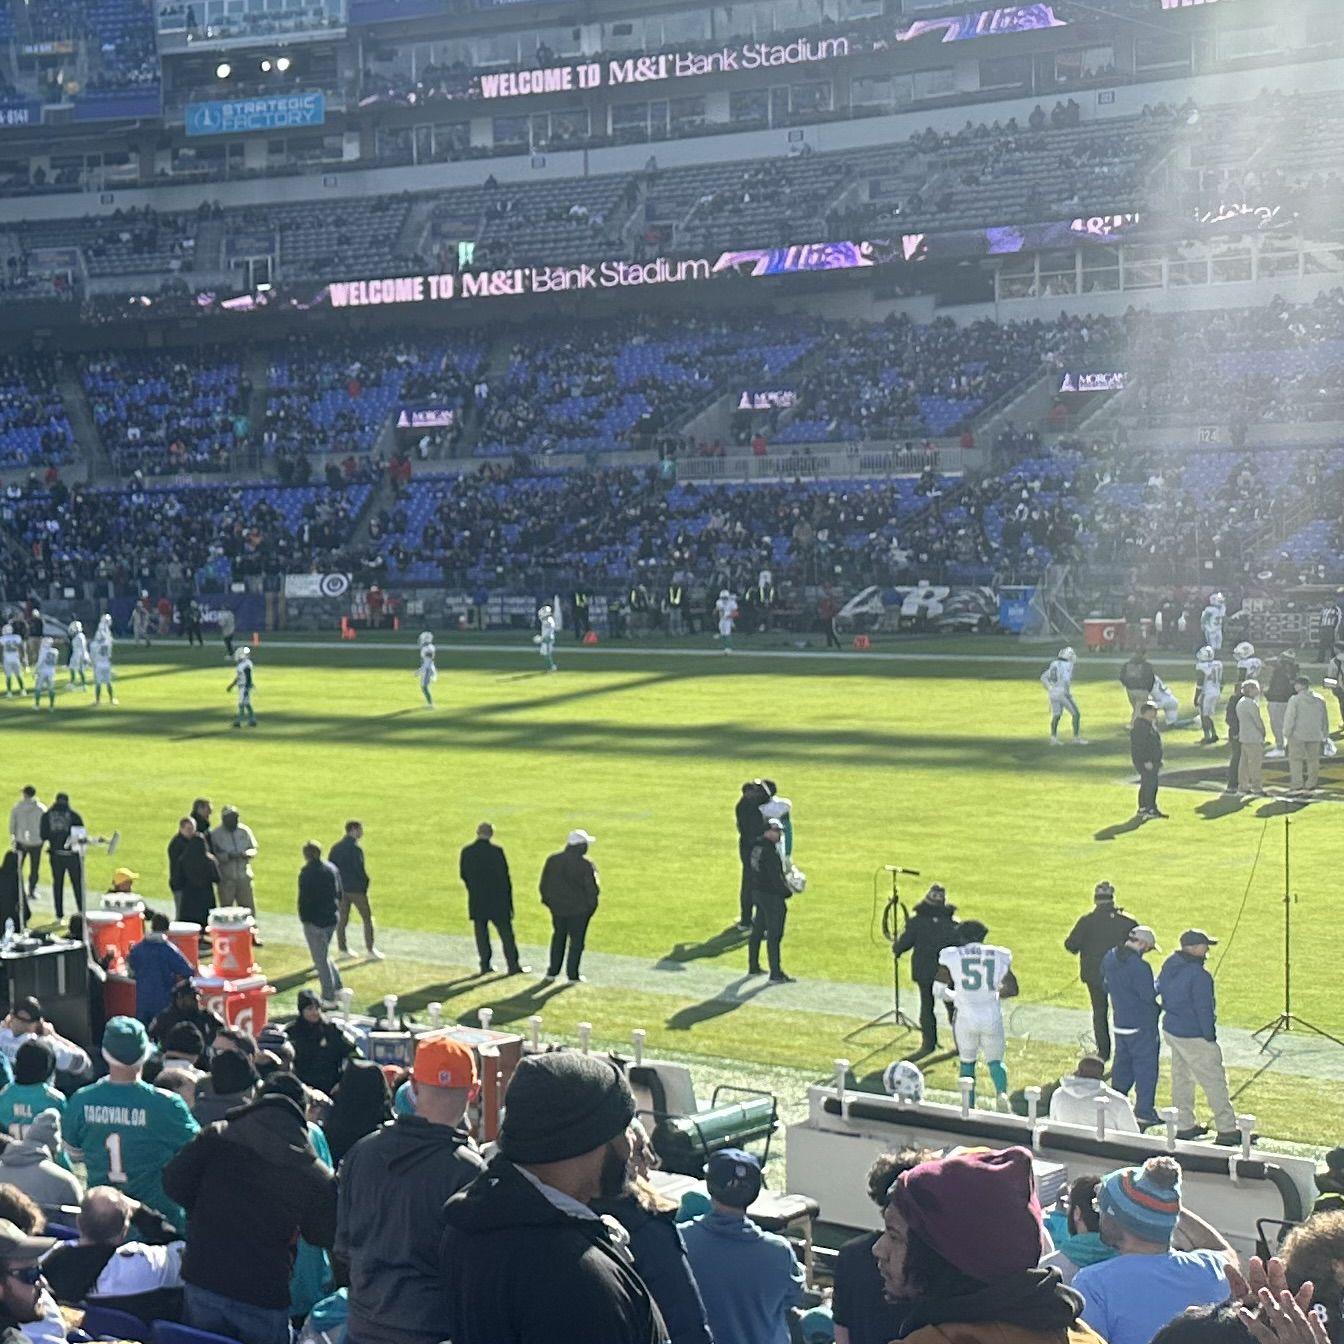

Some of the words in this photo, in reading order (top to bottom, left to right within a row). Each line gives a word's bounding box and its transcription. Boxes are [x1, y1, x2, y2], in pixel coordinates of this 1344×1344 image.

[481, 66, 572, 98] WELCOME
[576, 63, 601, 89] TO
[608, 52, 674, 86] M&T
[675, 47, 739, 77] Bank
[742, 37, 848, 69] Stadium
[223, 95, 314, 115] STRATEGIC
[223, 108, 314, 130] FACTORY
[329, 276, 424, 307] WELCOME
[427, 274, 454, 300] TO
[461, 267, 530, 298] M&T
[532, 263, 597, 292] Bank
[600, 257, 710, 287] Stadium
[1103, 626, 1115, 640] G
[217, 936, 231, 955] G
[960, 958, 995, 991] 51
[83, 1104, 147, 1127] TAGOVAILOA
[105, 1132, 129, 1183] 1
